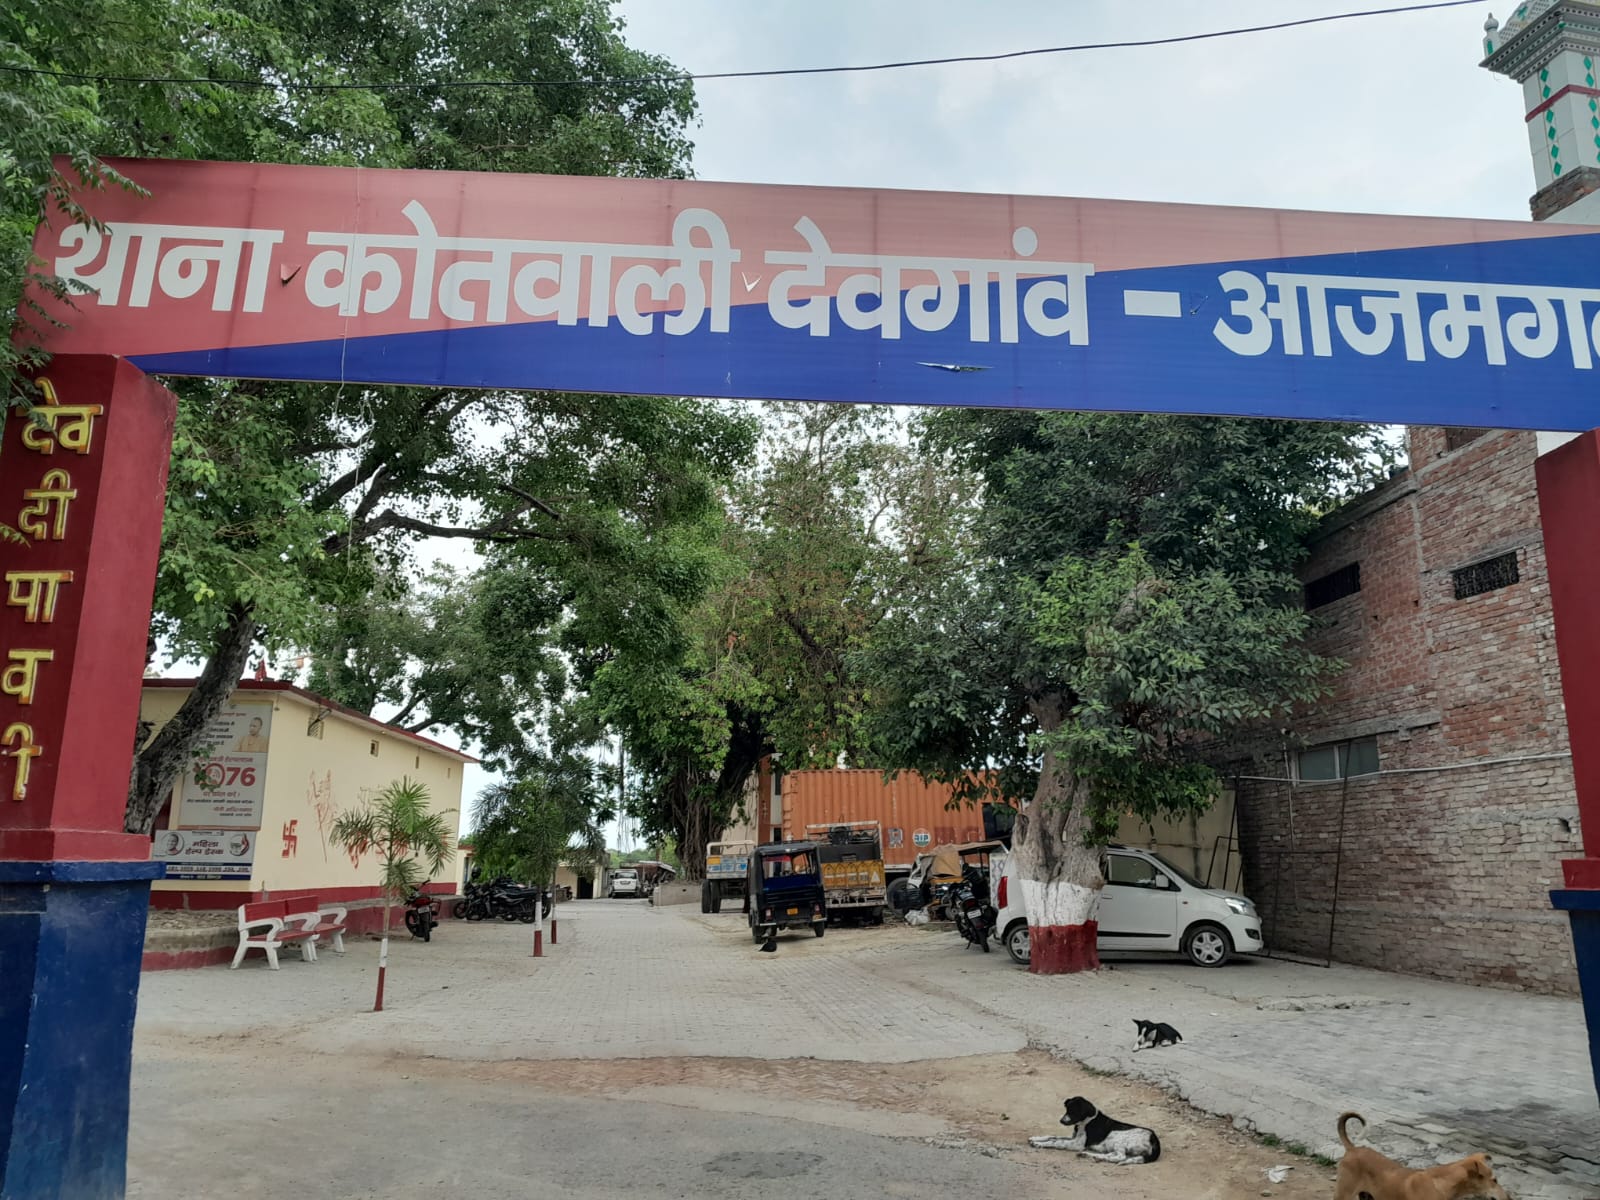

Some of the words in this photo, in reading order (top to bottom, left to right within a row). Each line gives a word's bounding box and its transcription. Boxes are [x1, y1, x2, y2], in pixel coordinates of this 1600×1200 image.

[54, 221, 284, 313] थाना
[305, 200, 741, 336] कोतवाली
[764, 216, 1095, 346] देवगांव
[1212, 270, 1600, 370] आजमग
